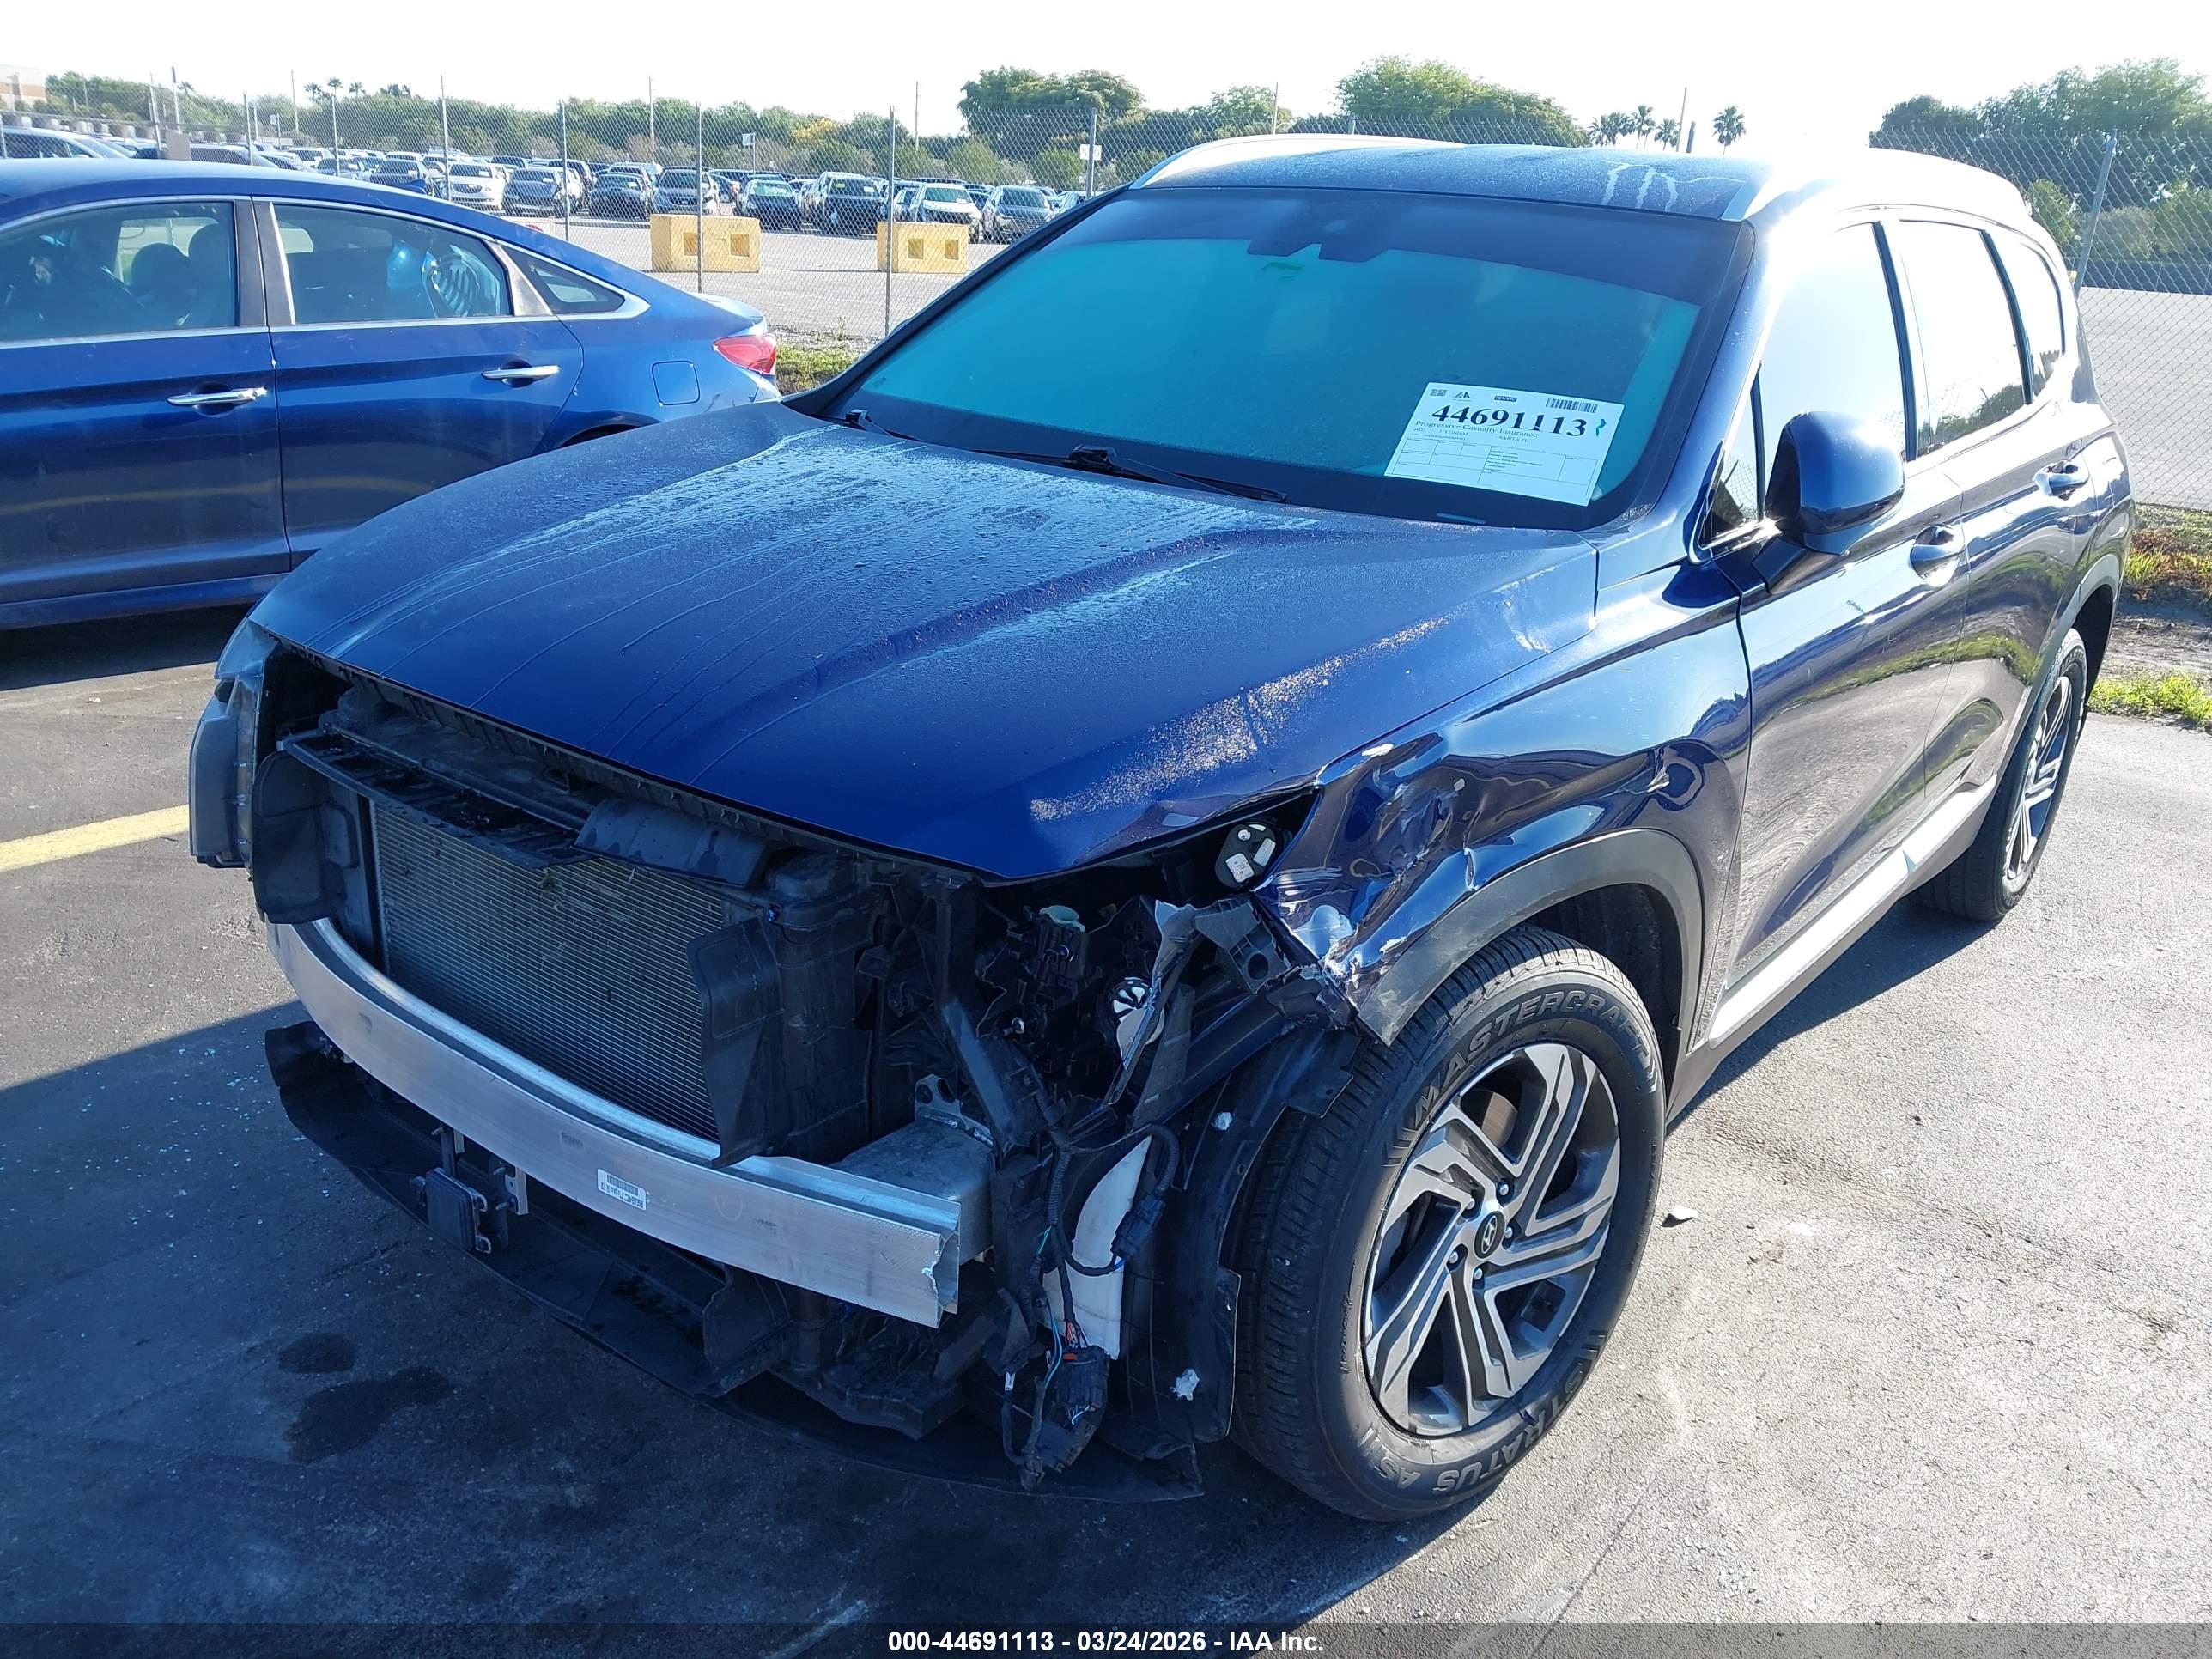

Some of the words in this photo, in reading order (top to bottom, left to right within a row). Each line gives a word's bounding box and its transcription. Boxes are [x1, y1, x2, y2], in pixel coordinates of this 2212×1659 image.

[1415, 420, 1462, 430] Progressive
[1462, 424, 1498, 434] Casualty
[1498, 428, 1539, 438] Insurance
[1431, 404, 1588, 437] 44691113
[1413, 989, 1650, 1129] MASTERCRAFT
[1431, 1358, 1593, 1495] STRATUS
[1374, 1455, 1422, 1490] AS
